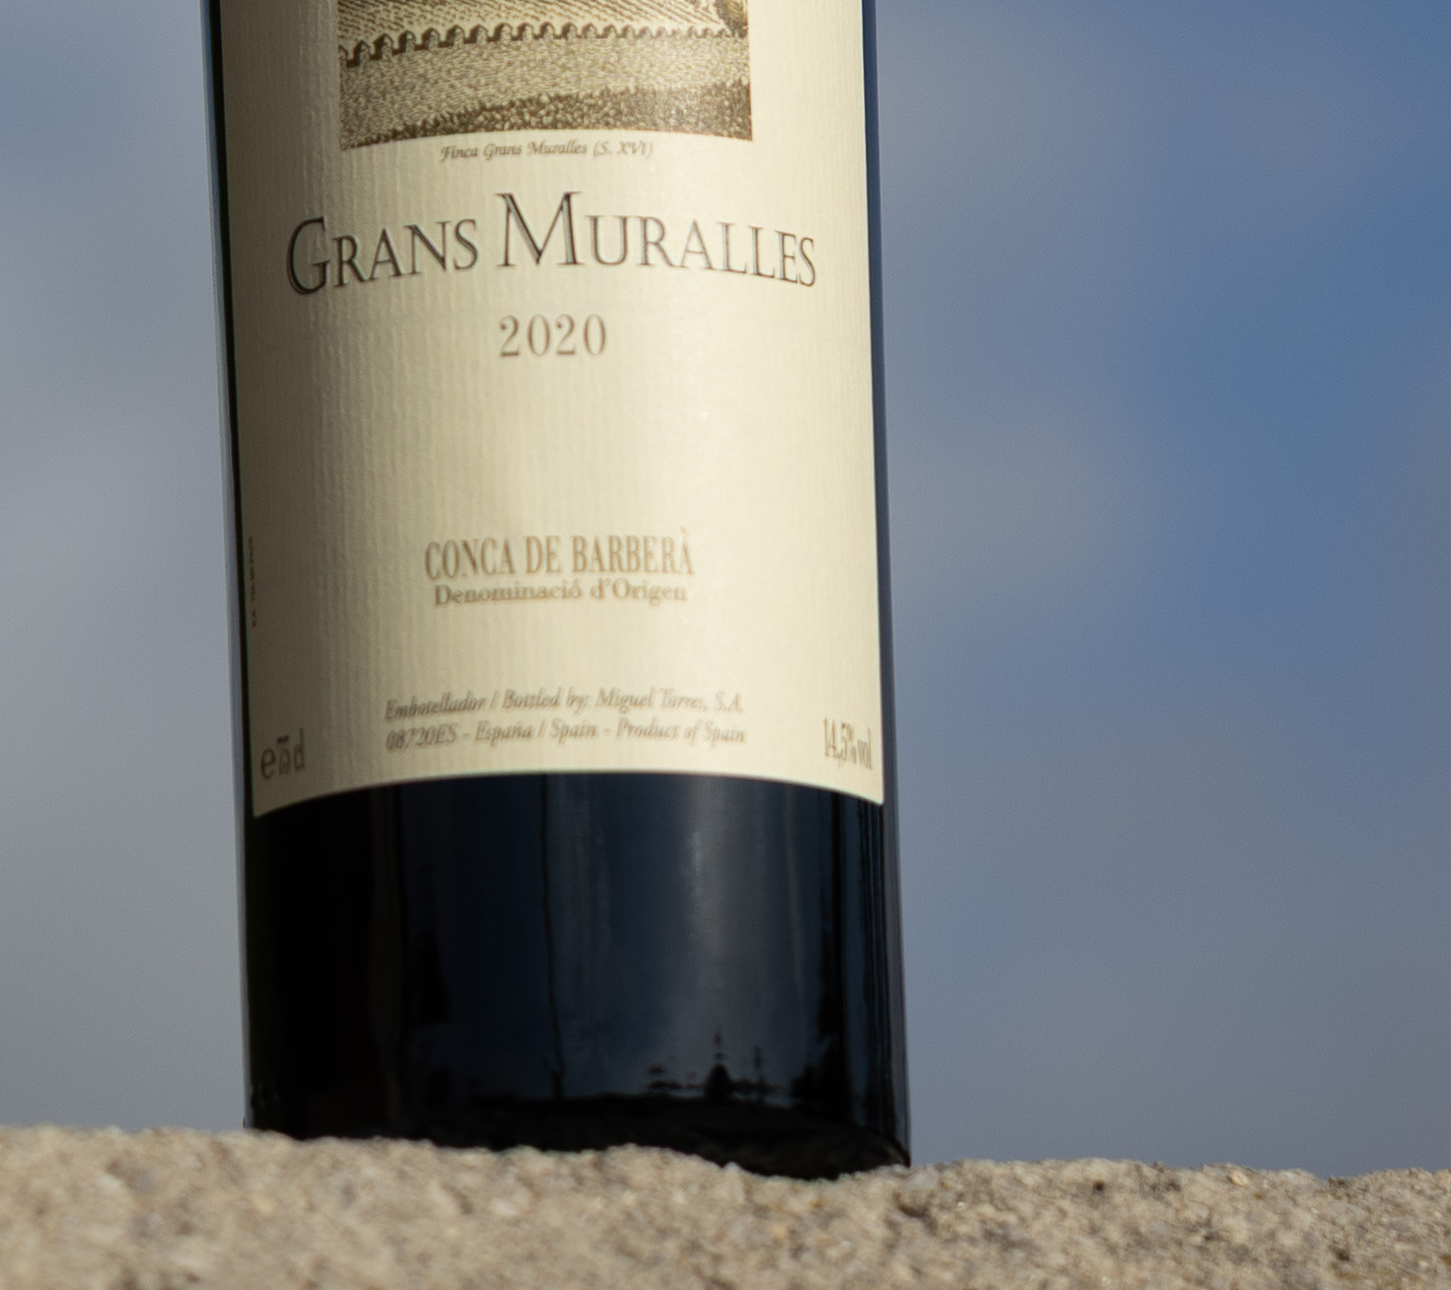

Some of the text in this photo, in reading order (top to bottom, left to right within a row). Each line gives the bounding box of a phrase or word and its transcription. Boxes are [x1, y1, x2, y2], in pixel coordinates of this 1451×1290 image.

[440, 145, 478, 162] Finca
[483, 143, 522, 161] Grans
[527, 139, 588, 156] Muralles
[498, 314, 607, 358] 2020
[424, 526, 695, 580] CONCA DE BARBERÀ
[434, 578, 583, 606] Denominació
[595, 687, 656, 714] Miguel
[551, 717, 598, 745] Spain
[616, 716, 679, 739] Product
[704, 719, 746, 748] Spain
